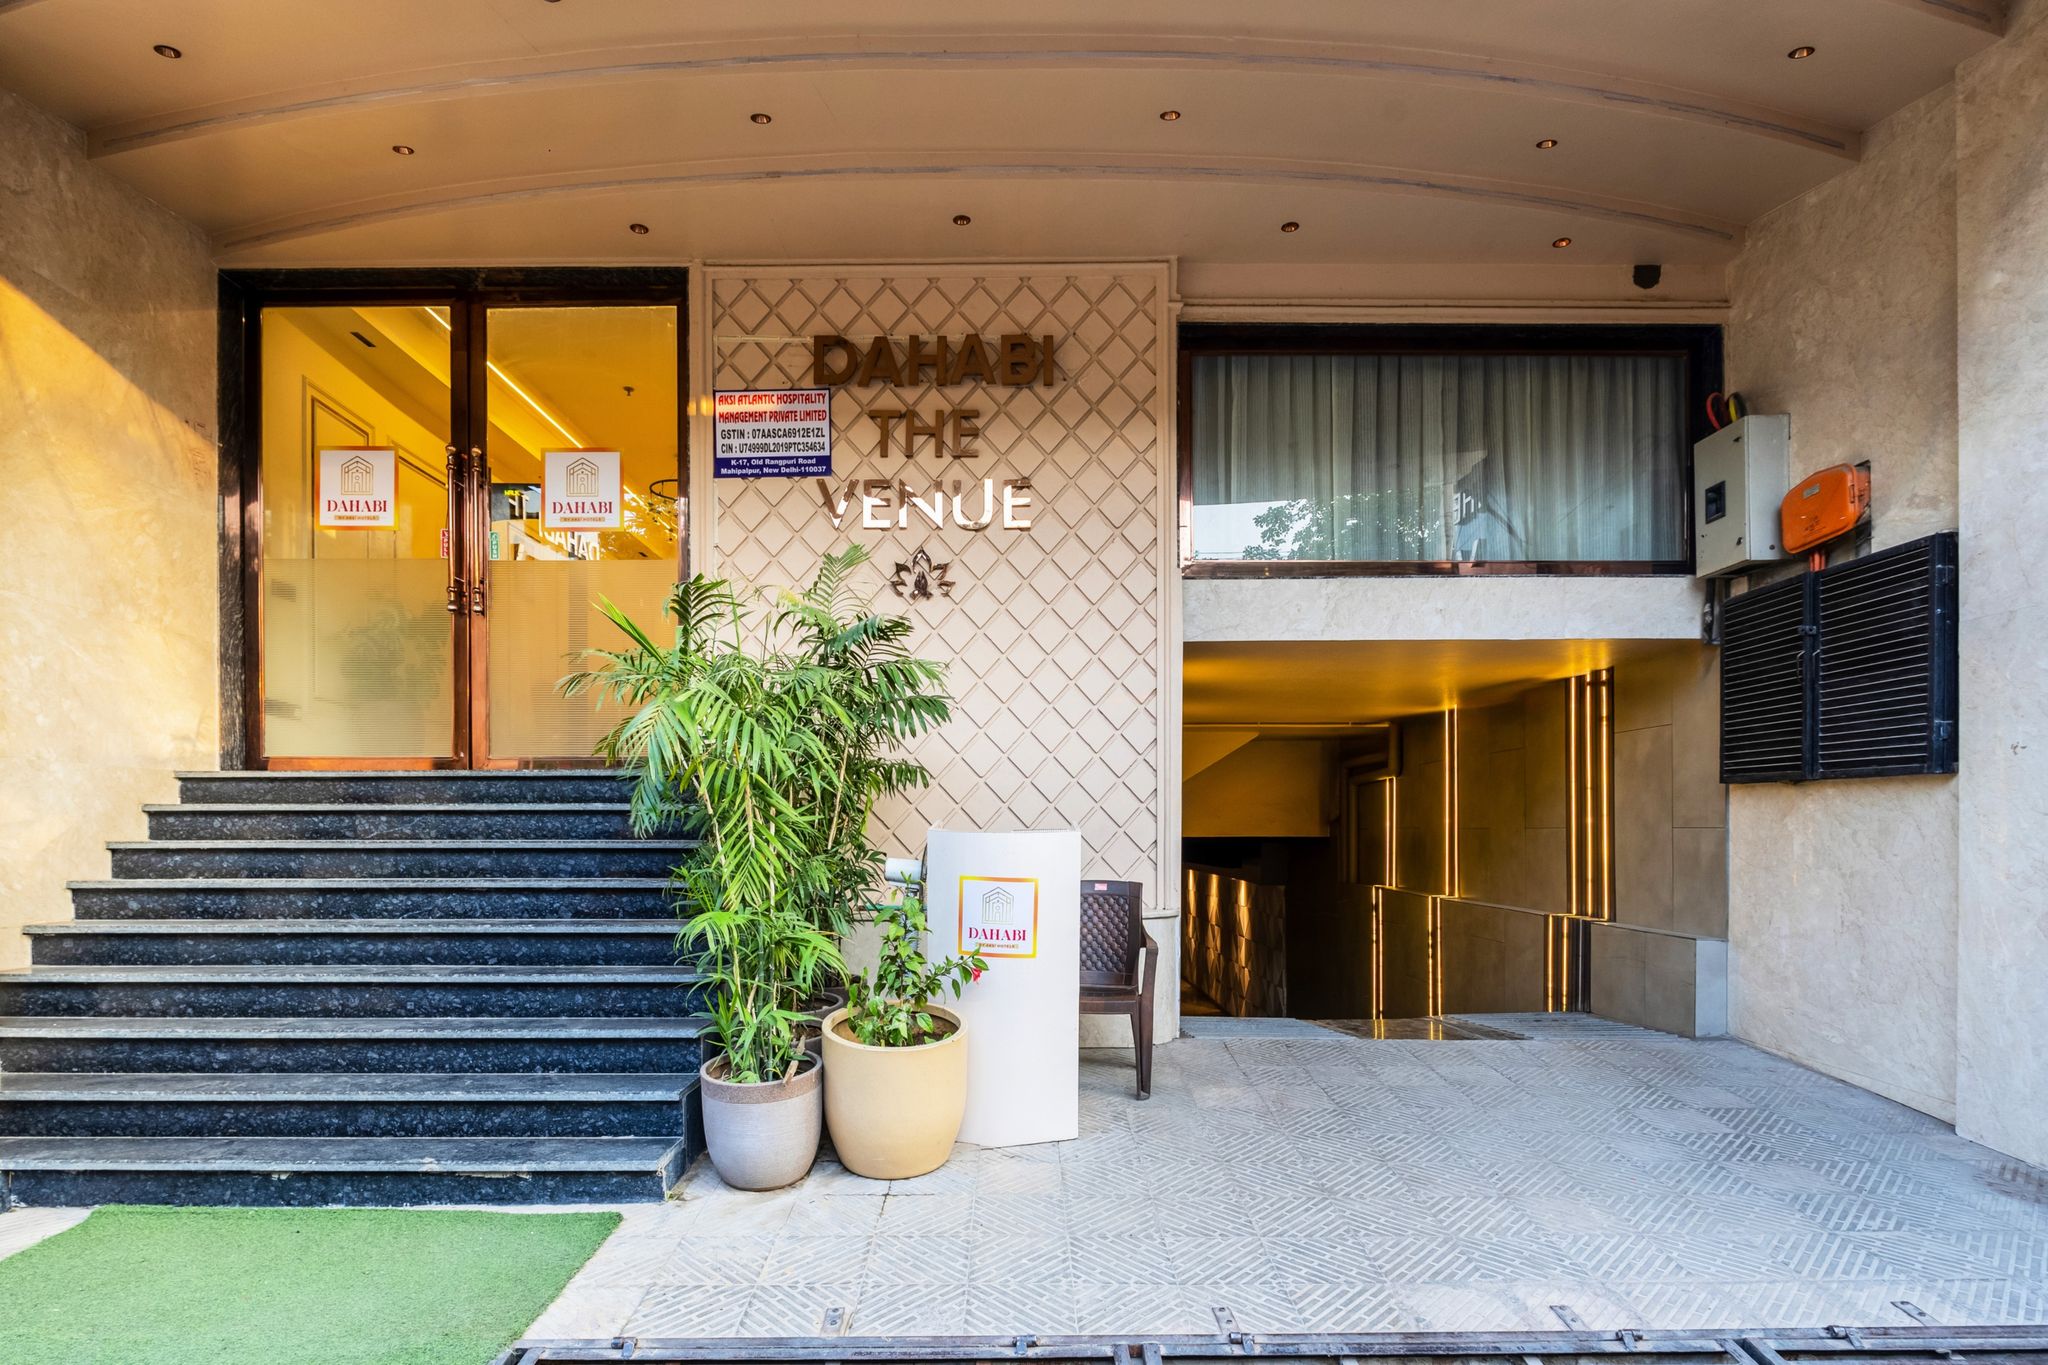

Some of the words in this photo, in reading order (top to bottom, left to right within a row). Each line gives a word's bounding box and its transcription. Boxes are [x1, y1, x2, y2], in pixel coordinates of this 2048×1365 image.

[813, 333, 1055, 387] DAHABI
[718, 393, 736, 406] AKSI
[738, 393, 776, 406] ATLANTIC
[777, 392, 827, 405] HOSPITALITY
[718, 411, 768, 423] MANAGEMENT
[769, 410, 798, 423] PRIVATE
[799, 409, 827, 422] LIMITED
[721, 429, 746, 440] GSTIN
[868, 409, 980, 458] THE
[721, 443, 733, 454] CIN
[731, 458, 750, 466] K-17,
[765, 458, 796, 467] Rangpuri
[798, 457, 816, 465] Road
[721, 467, 761, 475] Mahipalpur,
[780, 465, 827, 473] Delhi-110037
[327, 499, 387, 512] DAHABI
[552, 501, 613, 514] DAHABI
[817, 478, 1032, 530] VENUE
[968, 927, 1026, 941] DAHABI
